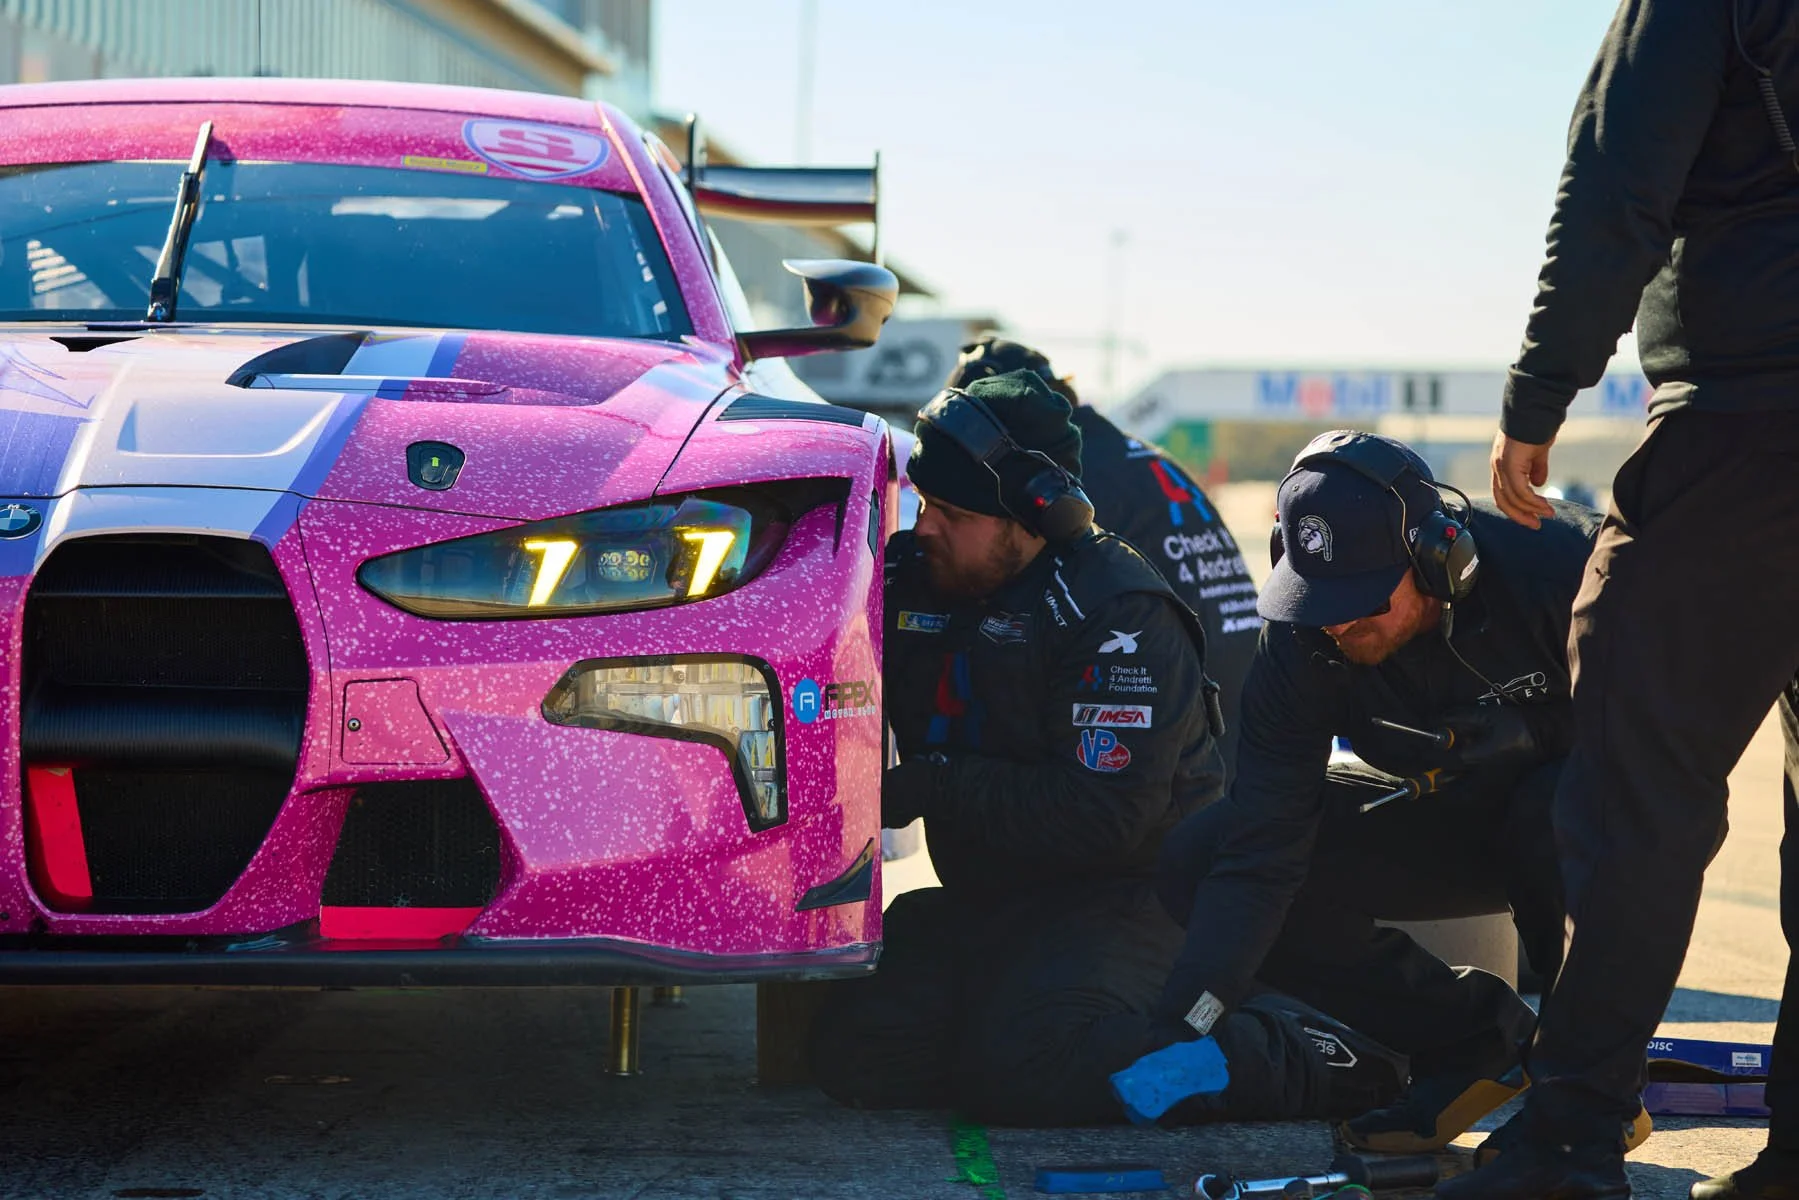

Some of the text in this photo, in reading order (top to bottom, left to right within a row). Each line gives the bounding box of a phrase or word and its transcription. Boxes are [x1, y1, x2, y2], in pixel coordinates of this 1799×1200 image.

[1163, 528, 1223, 561] Check
[1178, 561, 1195, 584] 4
[1110, 665, 1147, 676] Check It
[1109, 675, 1152, 685] 4 Andretti
[1108, 683, 1158, 693] Foundation
[1096, 710, 1146, 724] IMSA
[1080, 729, 1118, 770] VP
[1646, 1041, 1674, 1052] DISC
